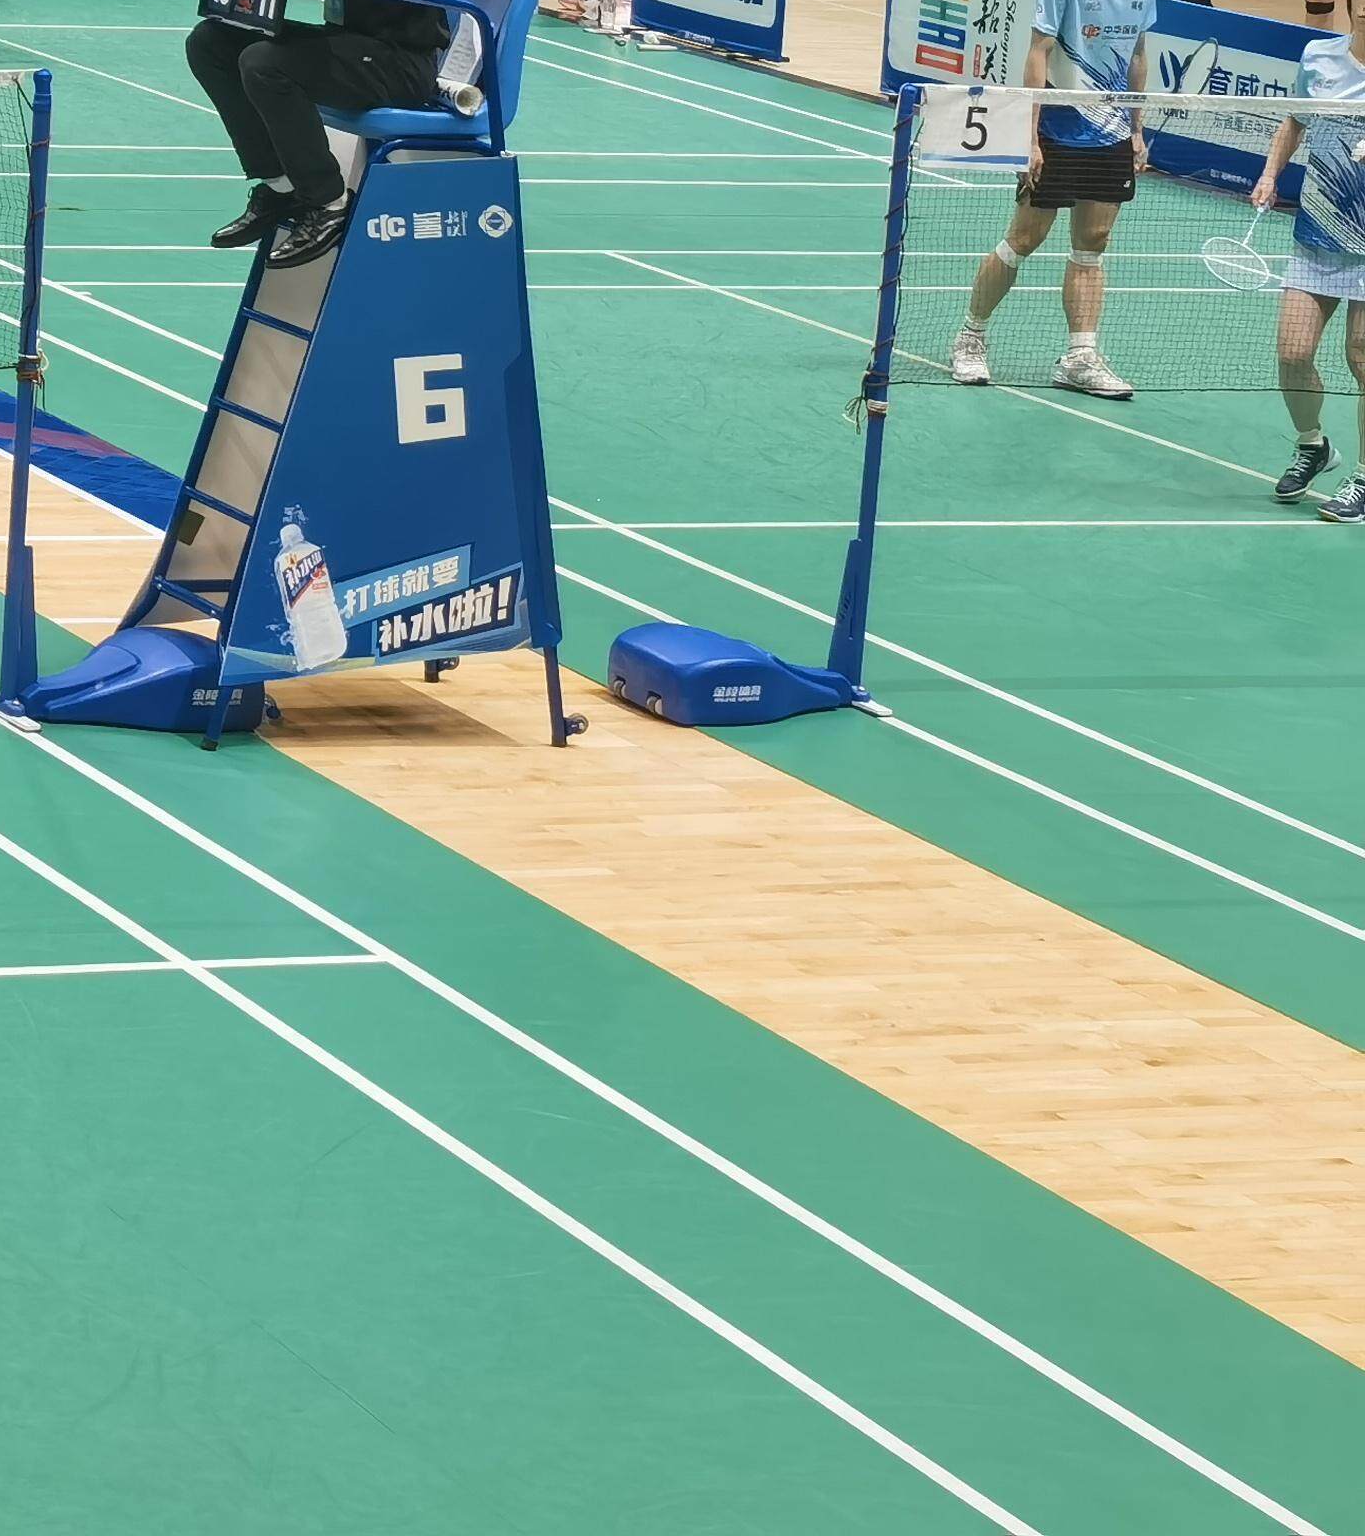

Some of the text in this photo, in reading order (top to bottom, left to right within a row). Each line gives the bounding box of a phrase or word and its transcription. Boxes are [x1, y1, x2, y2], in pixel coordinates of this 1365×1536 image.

[960, 105, 990, 152] 5
[393, 352, 468, 445] 6
[345, 555, 460, 617] 打球就要
[378, 575, 513, 652] 补水啦!
